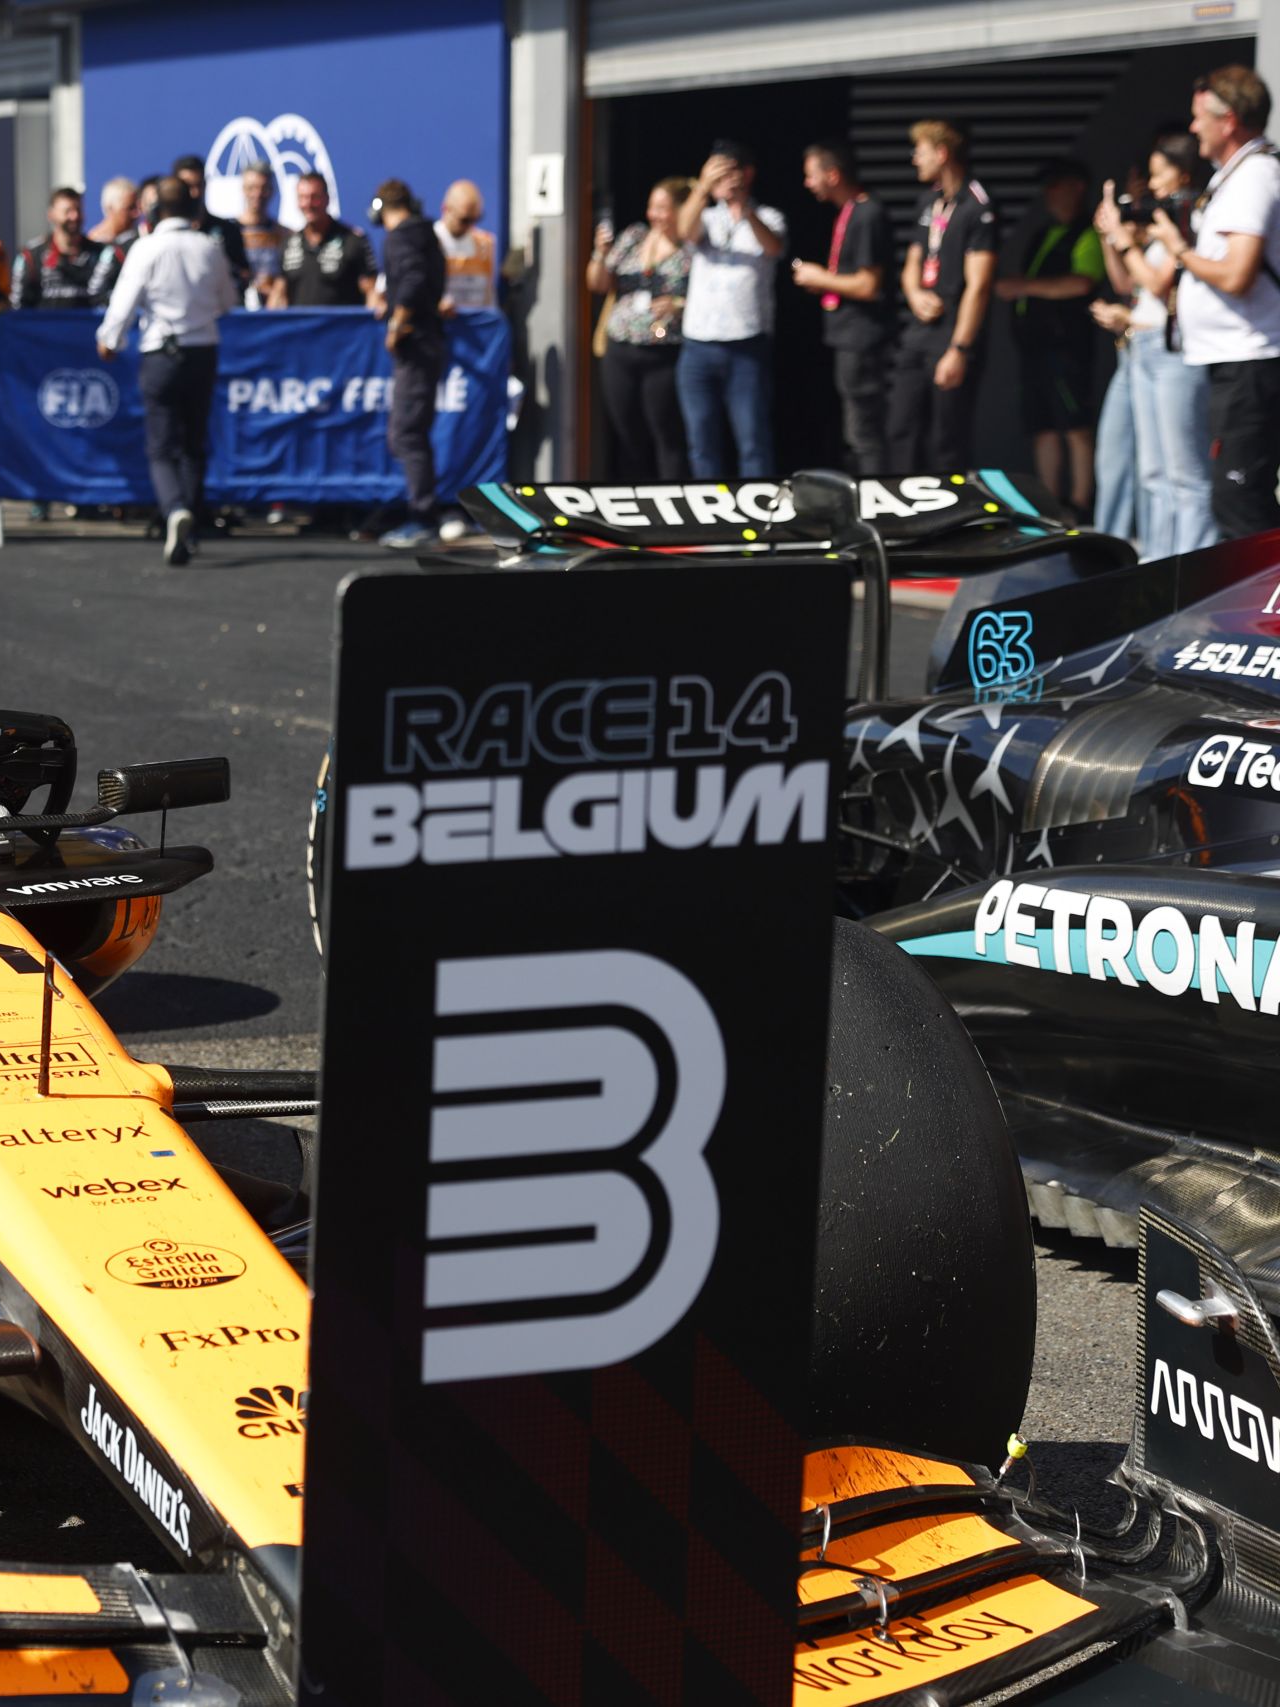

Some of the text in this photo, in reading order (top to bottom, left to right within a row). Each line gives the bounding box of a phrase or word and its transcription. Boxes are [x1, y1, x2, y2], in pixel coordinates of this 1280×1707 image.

[228, 366, 468, 413] PARC FEÉ
[543, 476, 958, 527] PETROAS
[968, 610, 1035, 688] 63
[384, 670, 798, 774] RACE 14
[345, 759, 830, 871] BELGIUM
[6, 873, 144, 896] vmware
[0, 1071, 40, 1081] THE
[52, 1069, 101, 1080] STAY
[41, 1177, 189, 1198] webex
[422, 948, 727, 1385] 3
[126, 1251, 219, 1268] Estrella
[137, 1263, 224, 1279] Galicia
[157, 1325, 301, 1351] FxPro
[80, 1383, 123, 1473] JACK
[238, 1417, 306, 1440] CN
[793, 1611, 1034, 1692] workday
